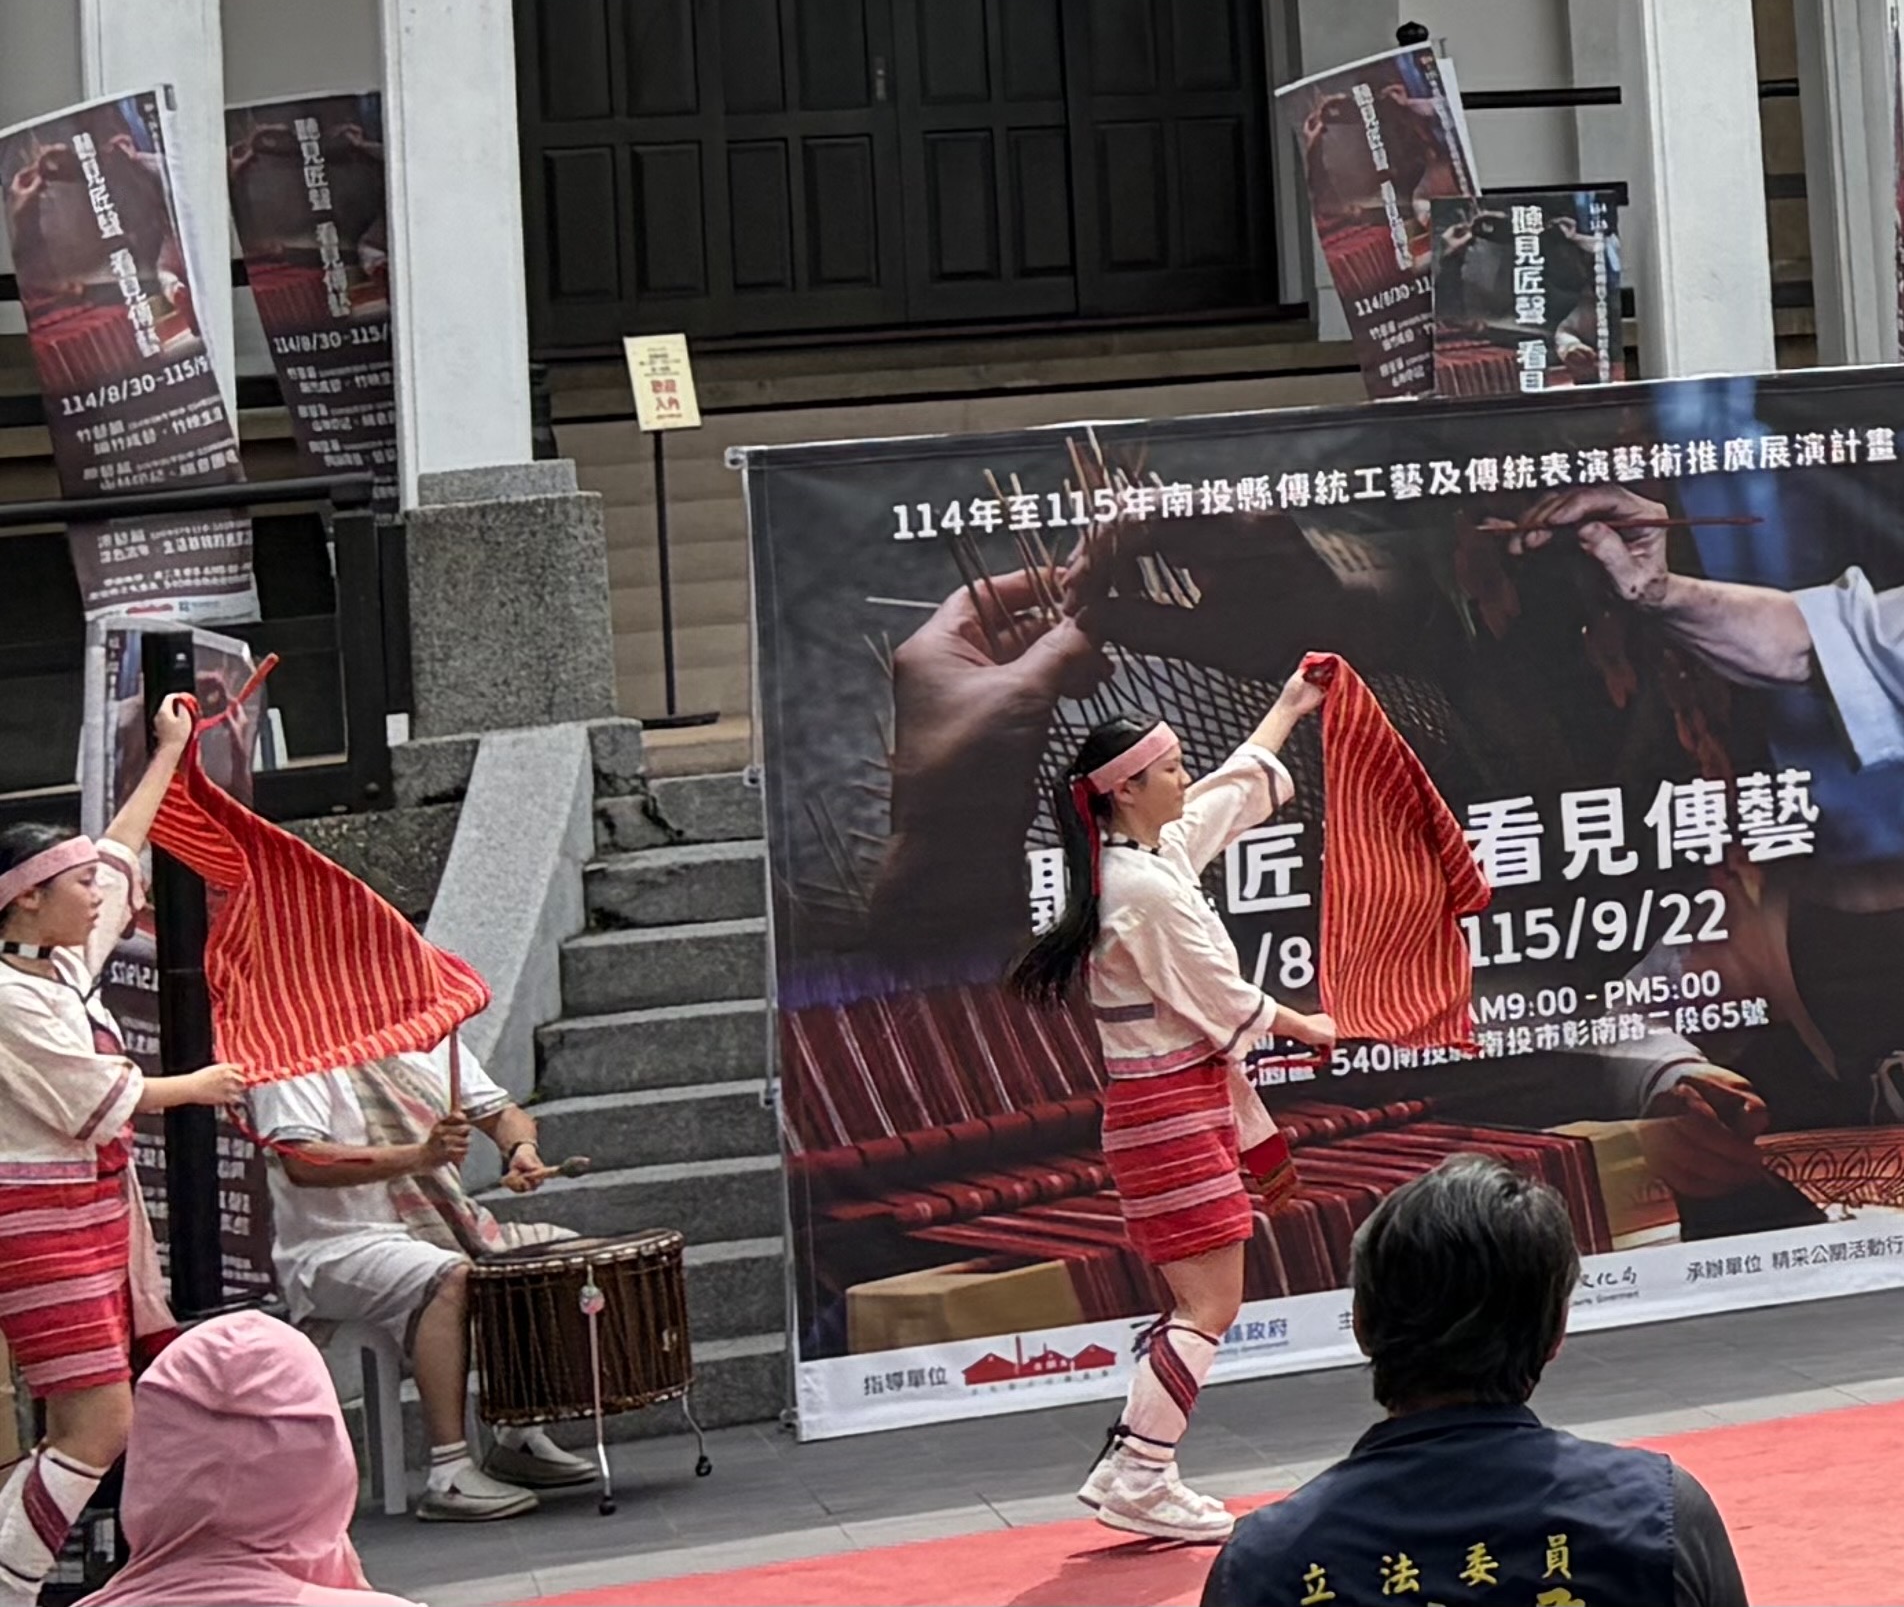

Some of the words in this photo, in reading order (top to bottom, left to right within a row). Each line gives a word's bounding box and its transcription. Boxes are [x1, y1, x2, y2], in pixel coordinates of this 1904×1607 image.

[1604, 969, 1722, 1009] PM5:00
[864, 1364, 949, 1397] 指導單位
[1300, 1533, 1574, 1606] 立法委員
